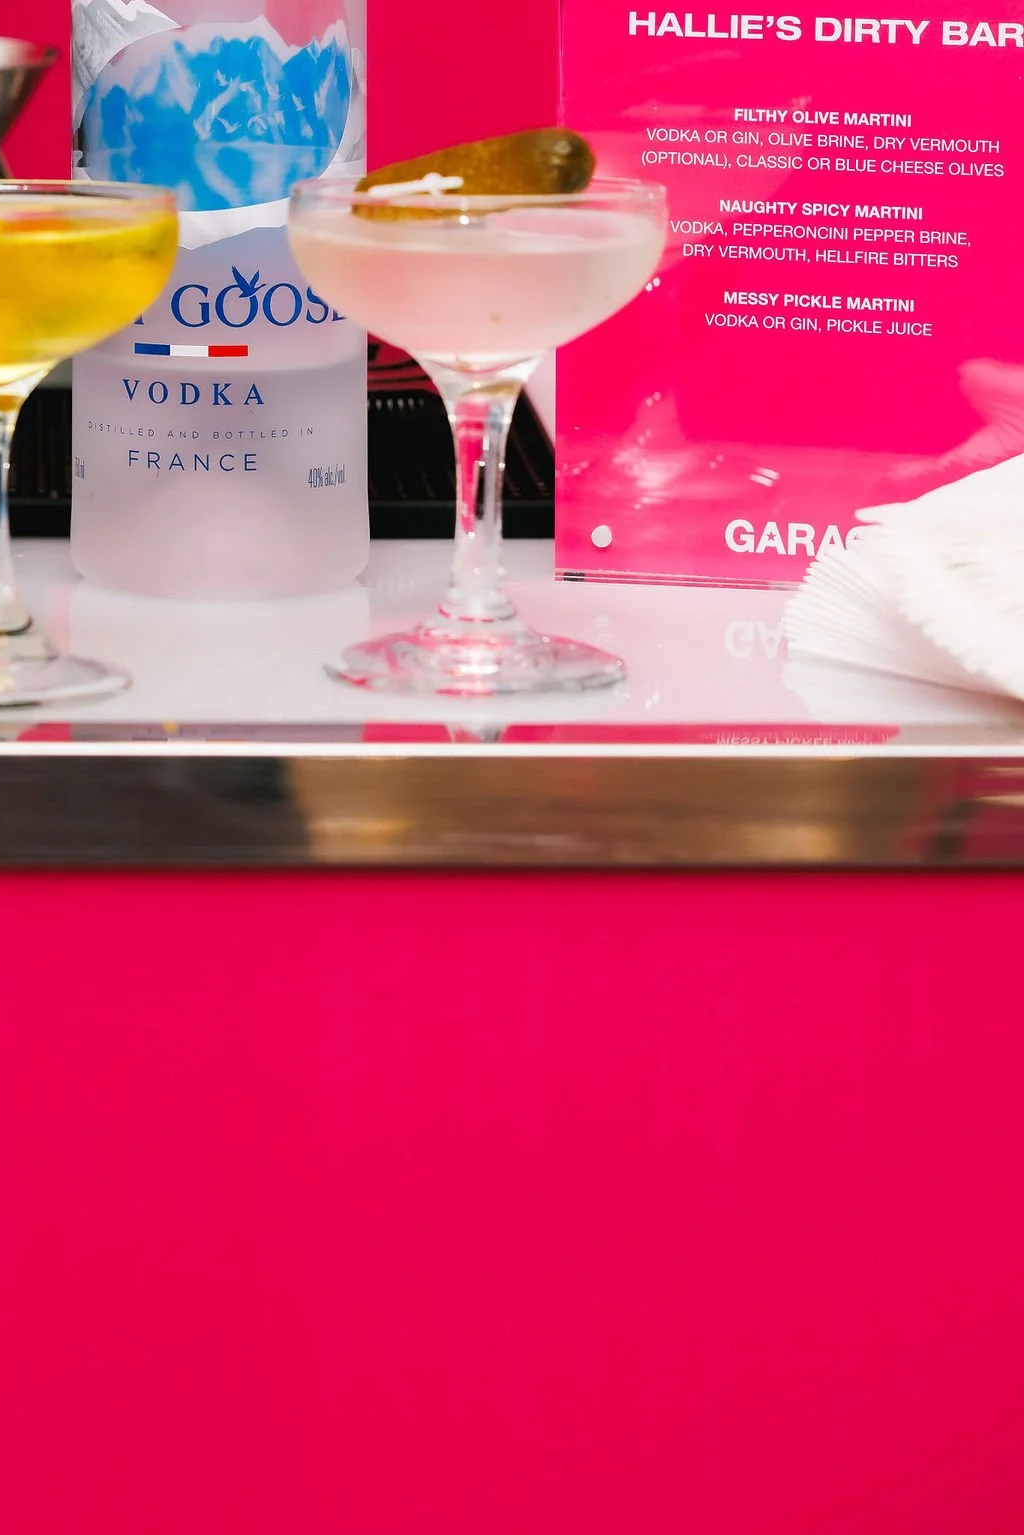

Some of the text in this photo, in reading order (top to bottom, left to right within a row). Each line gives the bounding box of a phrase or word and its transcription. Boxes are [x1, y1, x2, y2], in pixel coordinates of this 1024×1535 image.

[627, 11, 1024, 48] HALLIE'S DIRTY BAR
[734, 108, 912, 128] FILTHY OLIVE MARTINI
[646, 127, 1000, 154] VODKA OR GIN, OLIVE BRINE, DRY VERMOUTH
[641, 150, 1005, 177] (OPTIONAL), CLASSIC OR BLUE CHEESE OLIVES
[719, 199, 923, 221] NAUGHTY SPICY MARTINI
[670, 220, 972, 247] VODKA, PEPPERONCINI PEPPER BRINE,
[683, 243, 959, 268] DRY VERMOUTH, HELLFIRE BITTERS
[170, 282, 348, 329] GOOS
[723, 291, 915, 313] MESSY PICKLE MARTINI
[704, 313, 933, 337] VODKA OR GIN, PICKLE JUICE
[122, 378, 265, 406] VODKA
[88, 420, 313, 440] DISTILLED AND BOTTLED IN
[128, 449, 257, 472] FRANCE
[307, 466, 324, 488] 40%
